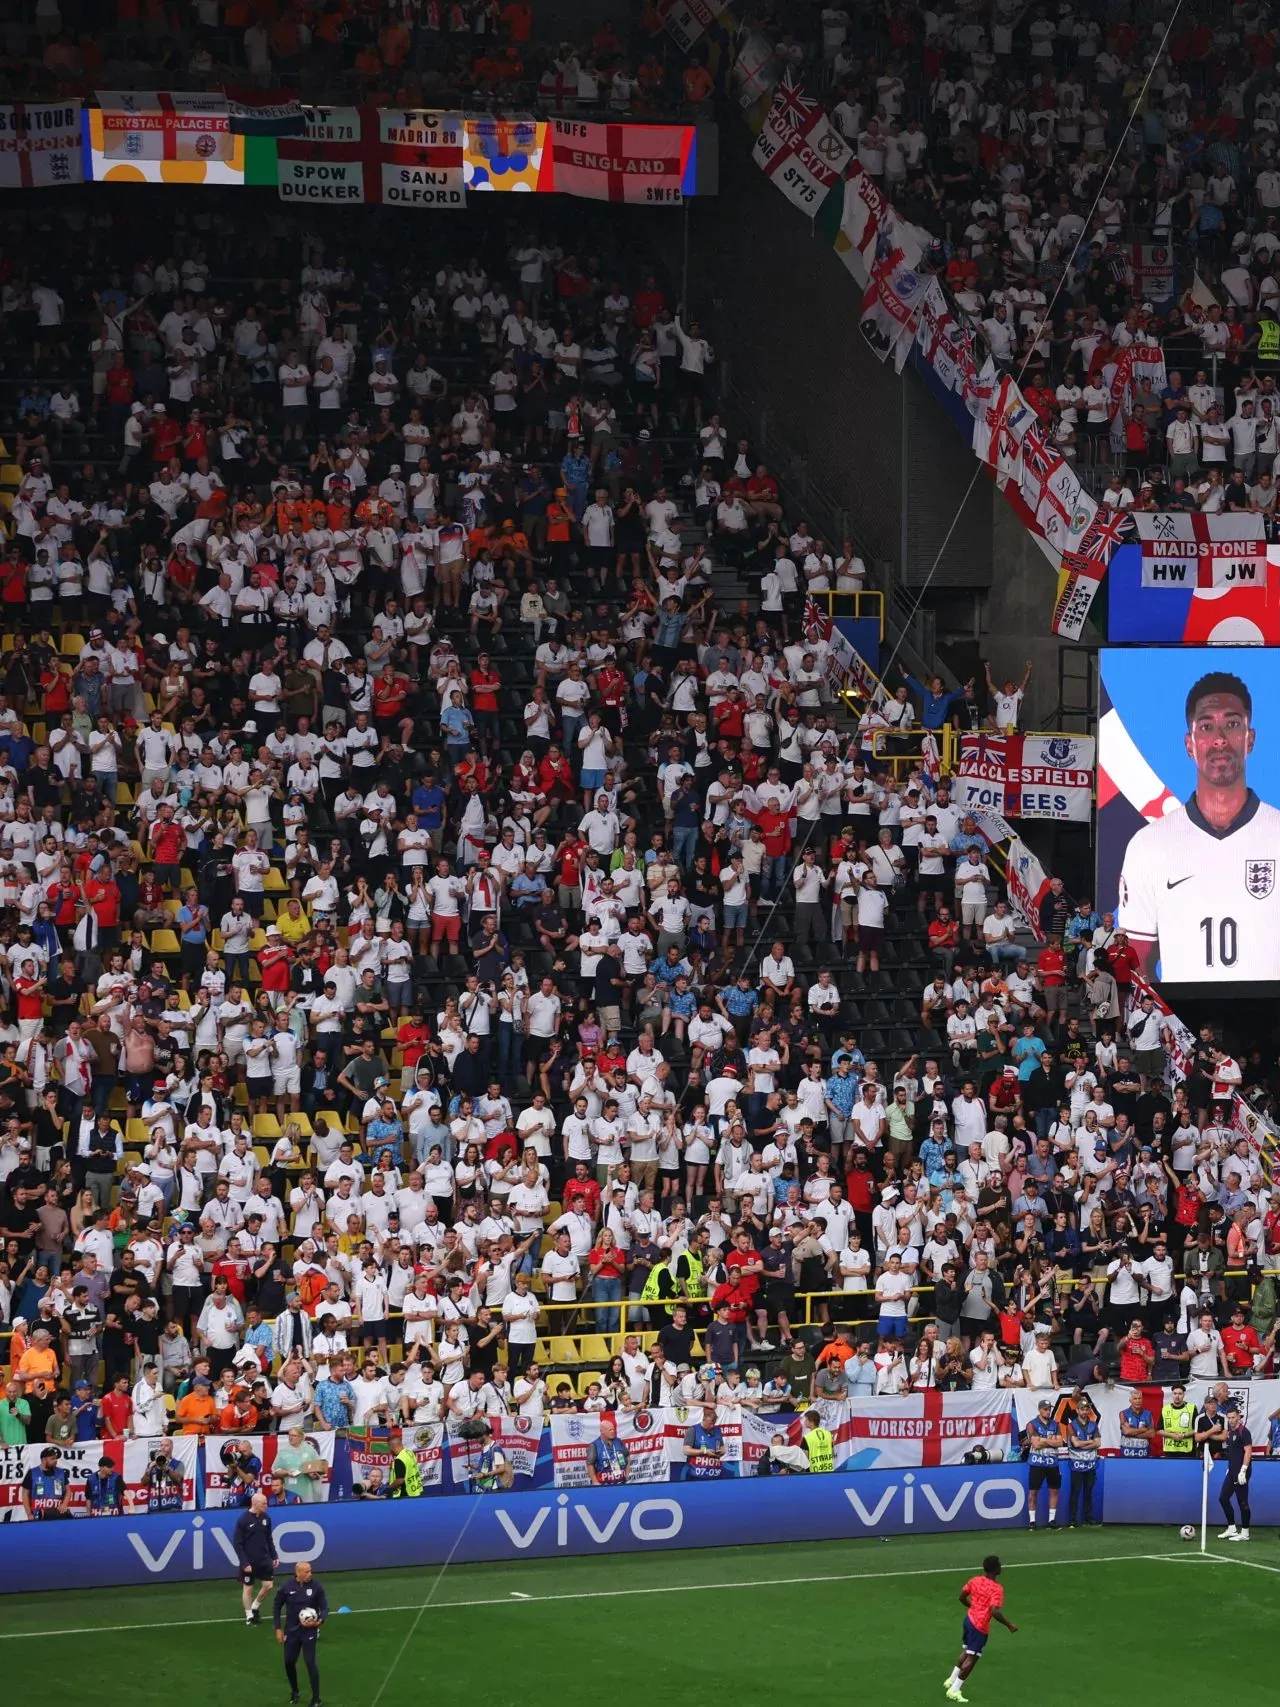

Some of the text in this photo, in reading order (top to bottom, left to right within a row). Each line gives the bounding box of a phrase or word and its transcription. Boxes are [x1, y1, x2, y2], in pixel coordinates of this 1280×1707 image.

[35, 108, 74, 129] TOUR
[107, 118, 162, 129] CRYSTAL
[165, 118, 212, 129] PALACE
[403, 111, 438, 128] FC
[303, 125, 457, 144] NICH MADRID 80
[556, 120, 587, 138] RUFC
[0, 135, 82, 152] CKPORT
[573, 152, 665, 173] ENGLAND
[798, 147, 833, 181] CITY
[294, 165, 448, 186] SPOW SANJ
[282, 183, 461, 205] DUCKER OLFORD
[647, 188, 681, 201] SWFC
[784, 168, 817, 203] ST15
[1153, 541, 1257, 557] MAIDSTONE
[1153, 564, 1256, 580] HW JW
[959, 761, 1089, 786] MACCLESFIELD
[967, 786, 1067, 811] TOFFEES
[1199, 916, 1240, 968] 10
[869, 1418, 997, 1437] WORKSOP TOWN FC
[4, 1445, 25, 1461] EY
[353, 1448, 440, 1465] BOSTON ITED
[557, 1449, 588, 1460] NETHER
[748, 1446, 768, 1458] LUT
[1032, 1454, 1055, 1465] 04-13
[4, 1463, 25, 1480] ES
[844, 1473, 1025, 1526] vivo
[495, 1493, 683, 1549] vivo
